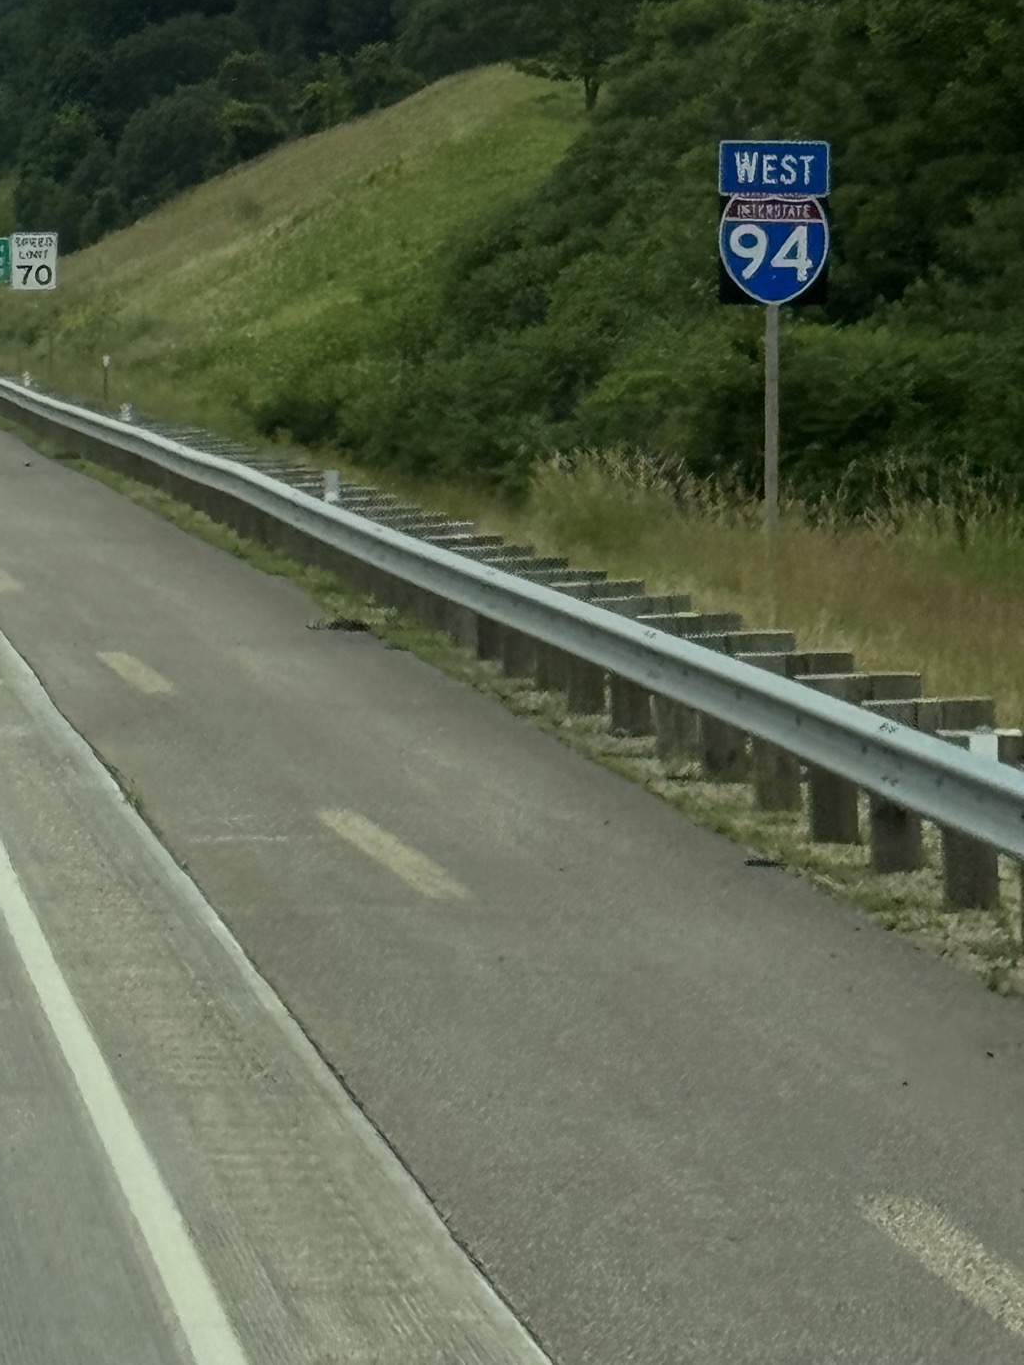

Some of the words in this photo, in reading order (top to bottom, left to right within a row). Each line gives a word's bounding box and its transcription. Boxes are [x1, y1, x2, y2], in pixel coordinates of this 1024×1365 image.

[734, 151, 815, 186] WEST
[736, 203, 812, 220] INTERSTATE
[729, 223, 814, 283] 94
[16, 264, 53, 286] 70
